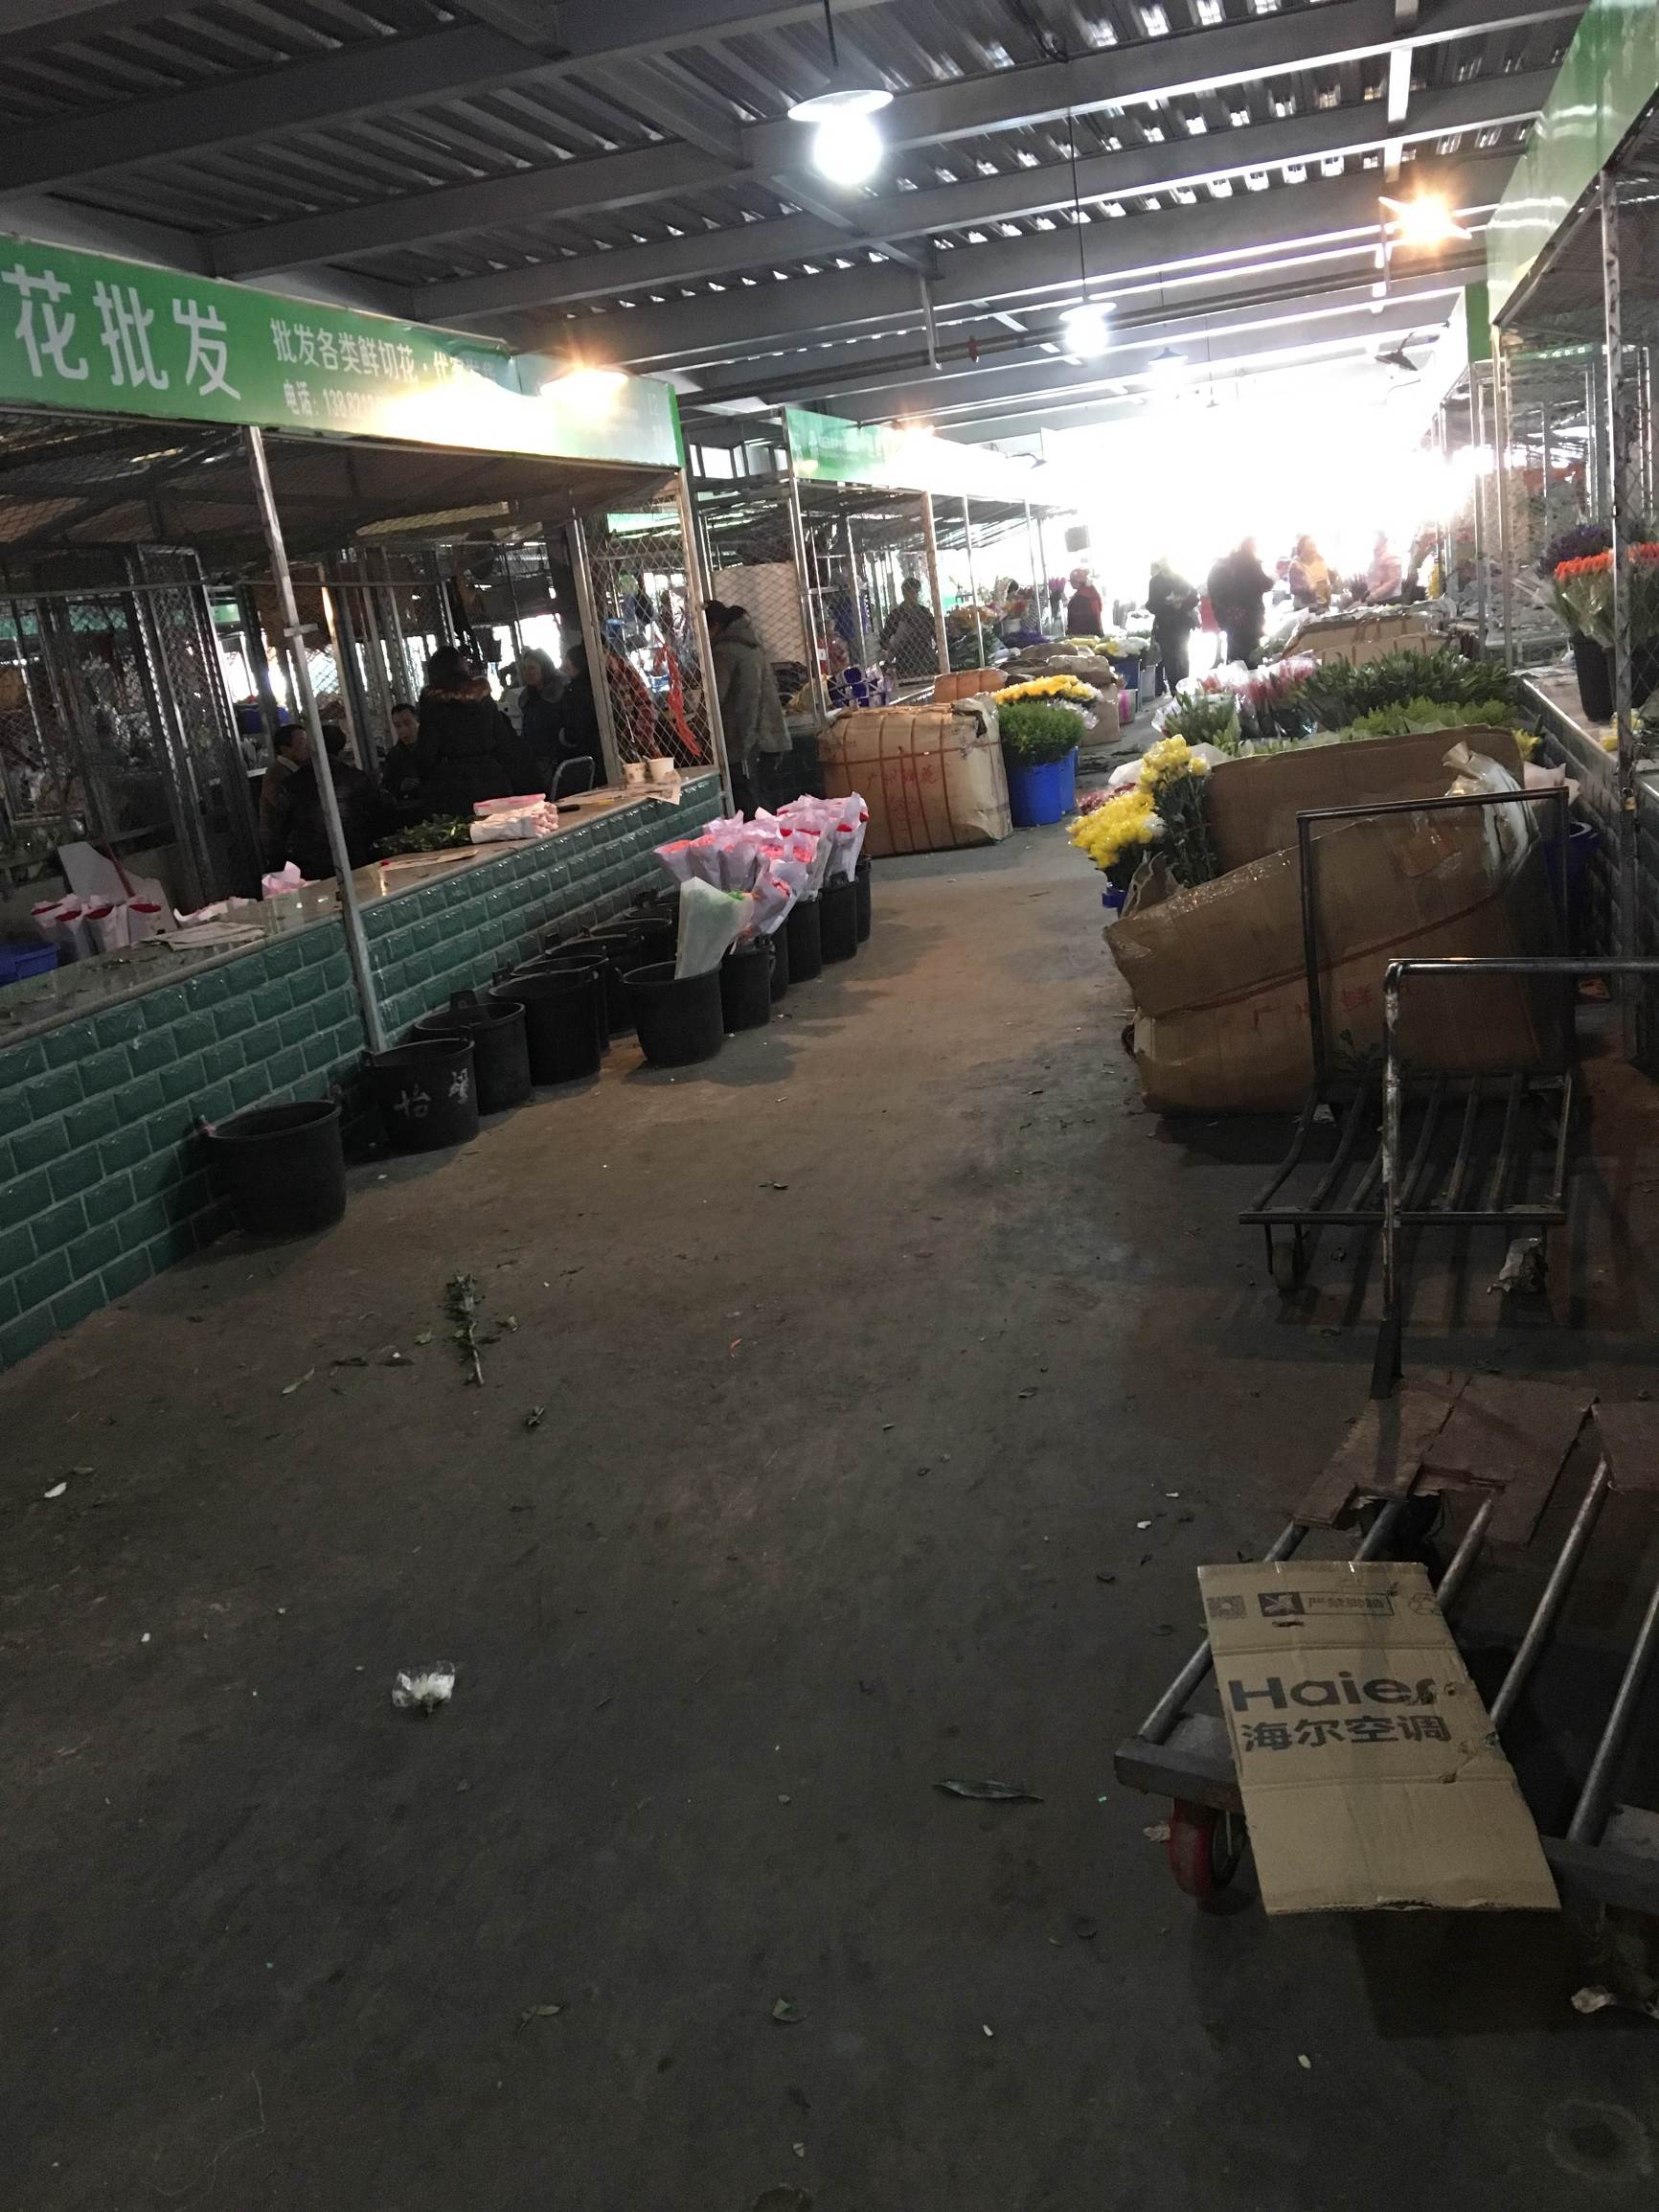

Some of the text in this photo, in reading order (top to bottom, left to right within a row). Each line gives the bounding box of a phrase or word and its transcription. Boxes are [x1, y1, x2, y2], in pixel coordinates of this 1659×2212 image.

[1, 263, 241, 400] 花批发
[1228, 1671, 1436, 1712] Haier
[1240, 1715, 1451, 1752] 海尔空调
